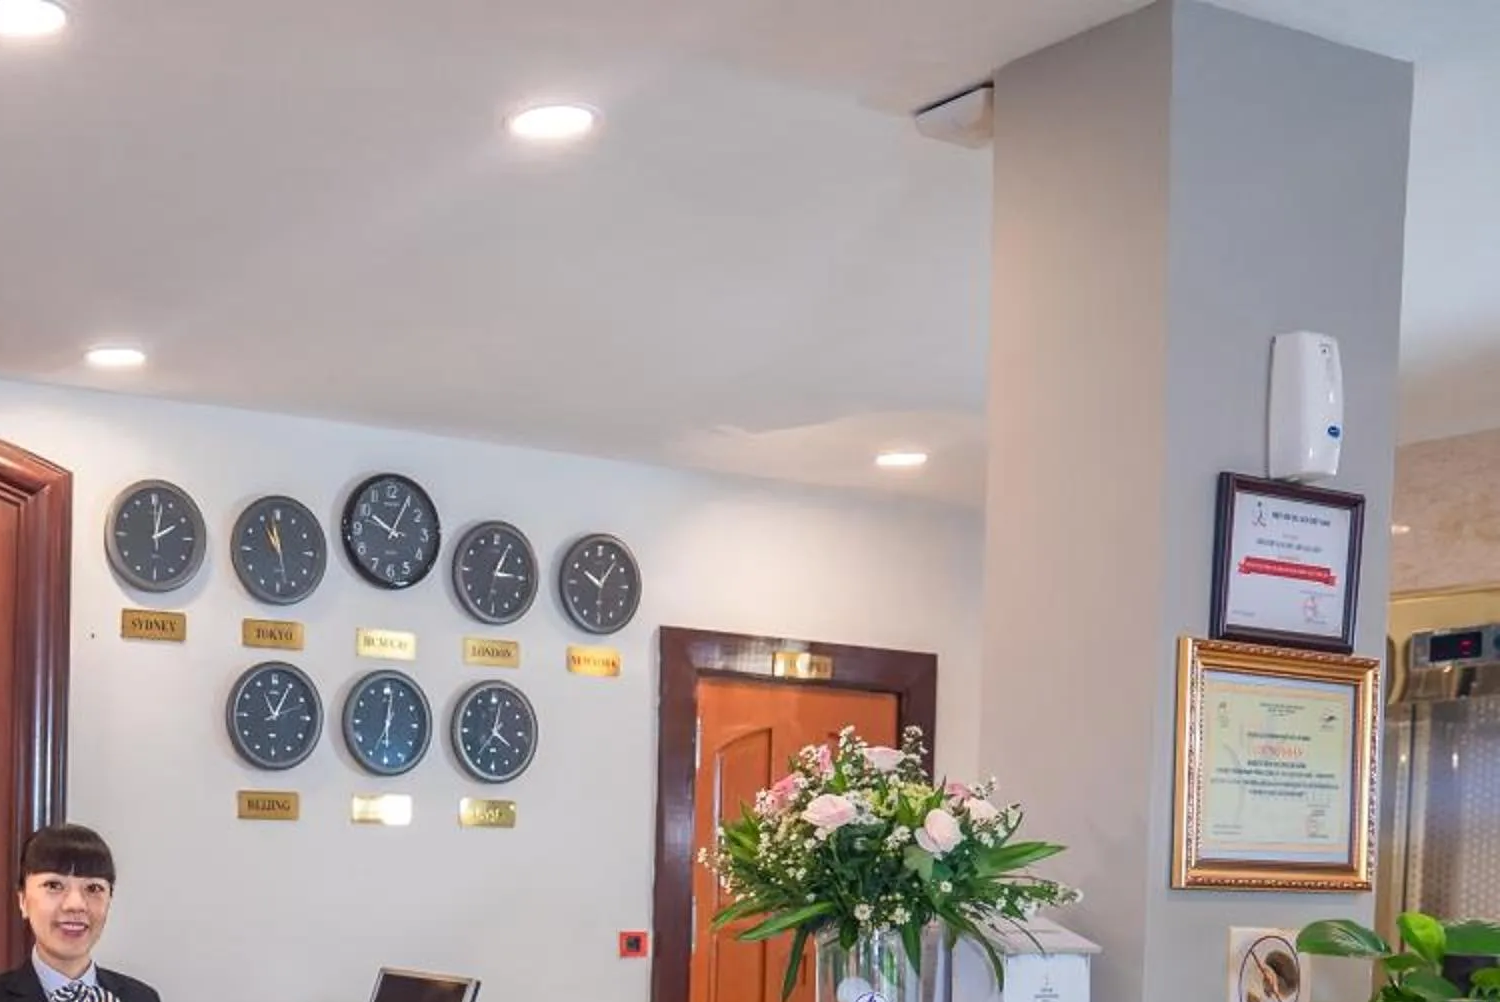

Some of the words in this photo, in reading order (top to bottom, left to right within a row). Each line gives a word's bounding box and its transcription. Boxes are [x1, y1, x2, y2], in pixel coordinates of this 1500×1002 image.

[387, 485, 397, 499] 12
[413, 508, 421, 523] 2
[421, 527, 428, 543] 3
[416, 547, 423, 561] 4
[372, 557, 379, 571] 7
[386, 564, 395, 578] 6
[402, 561, 410, 575] 5
[131, 617, 178, 632] SYDNEY
[255, 627, 293, 641] TOKYO
[471, 645, 513, 658] LONDON
[246, 799, 291, 812] BEIJING
